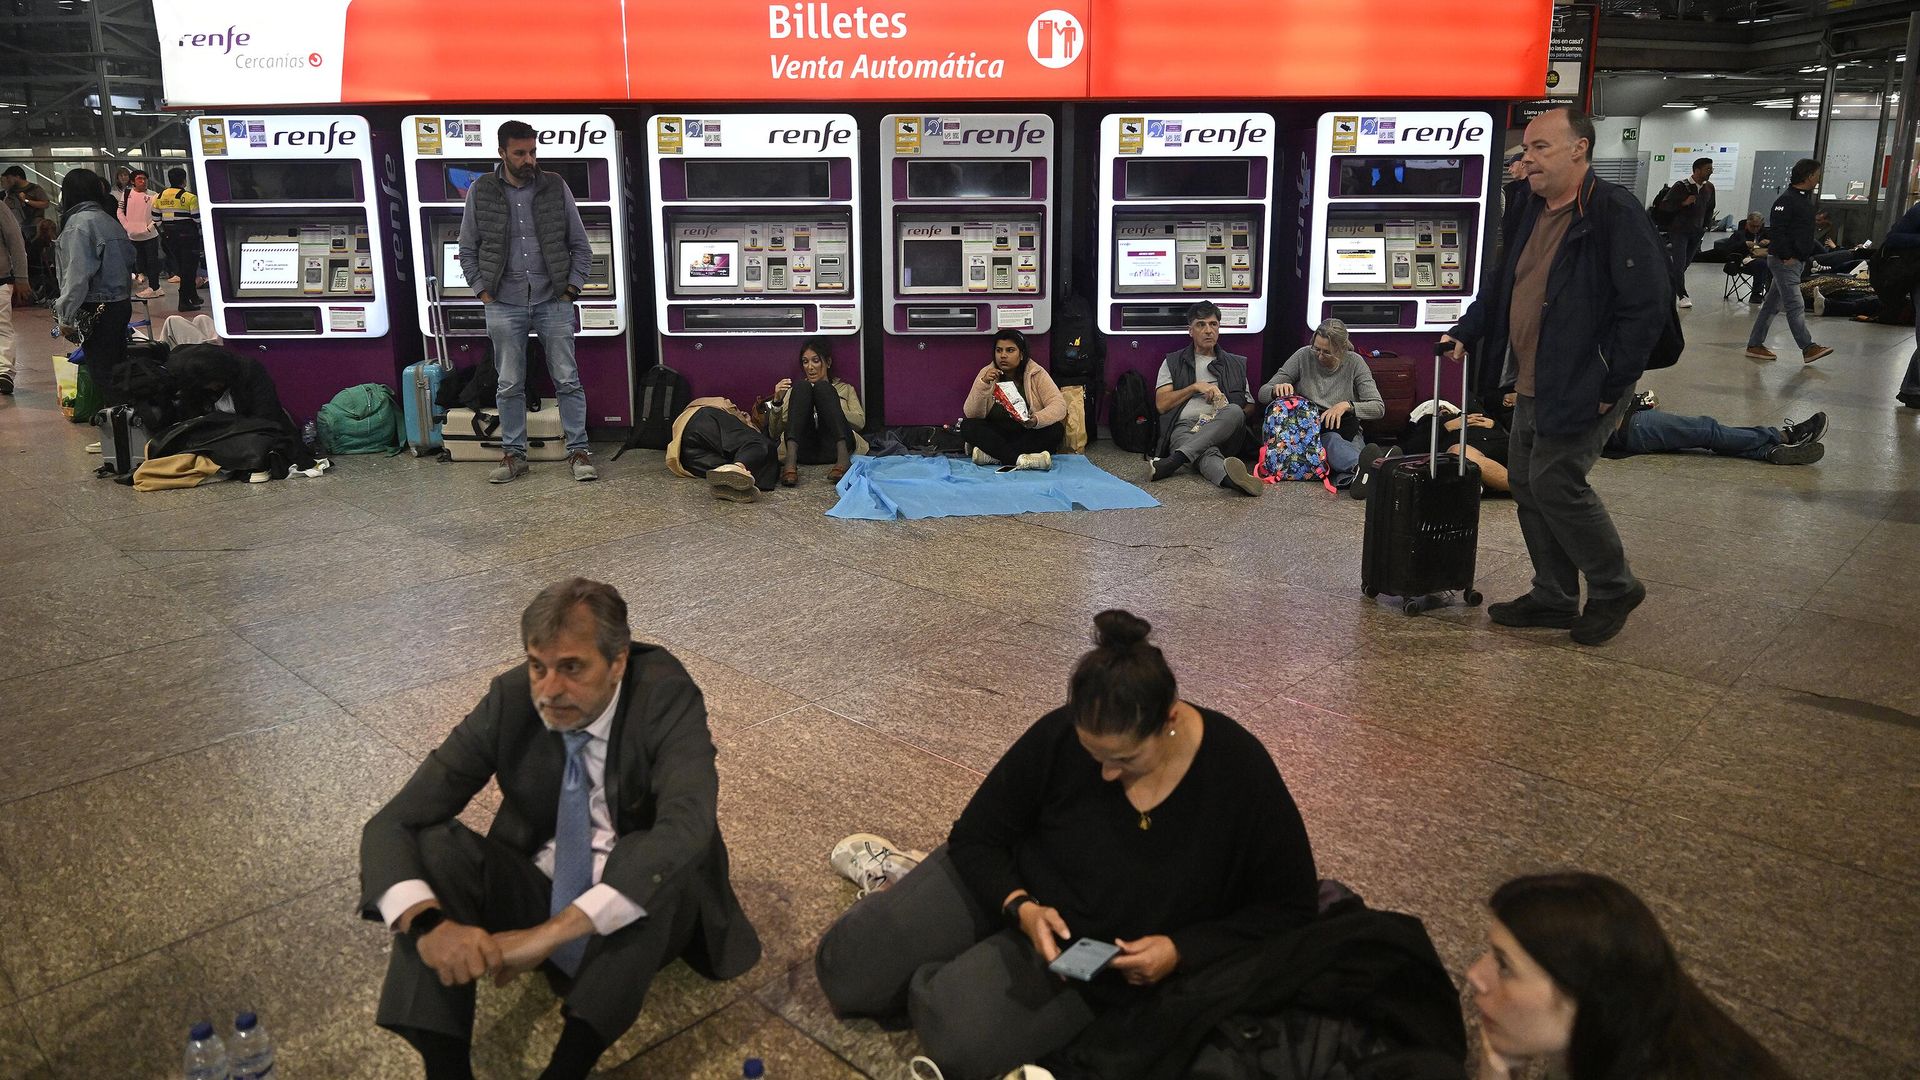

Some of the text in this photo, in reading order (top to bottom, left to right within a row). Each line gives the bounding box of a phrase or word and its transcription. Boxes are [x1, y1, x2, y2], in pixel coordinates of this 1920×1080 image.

[769, 3, 907, 39] Billetes
[179, 25, 251, 54] renfe
[235, 53, 304, 69] Cercanías
[771, 52, 1004, 79] Venta Automática
[274, 122, 355, 153] renfe
[536, 121, 606, 153] enfe
[769, 120, 851, 152] renfe
[962, 120, 1045, 152] renfe
[1184, 119, 1266, 151] renfe
[1402, 118, 1483, 150] renfe
[381, 153, 407, 282] renfe
[683, 225, 718, 238] renfe
[907, 224, 942, 238] renfe
[1121, 223, 1155, 237] renfe
